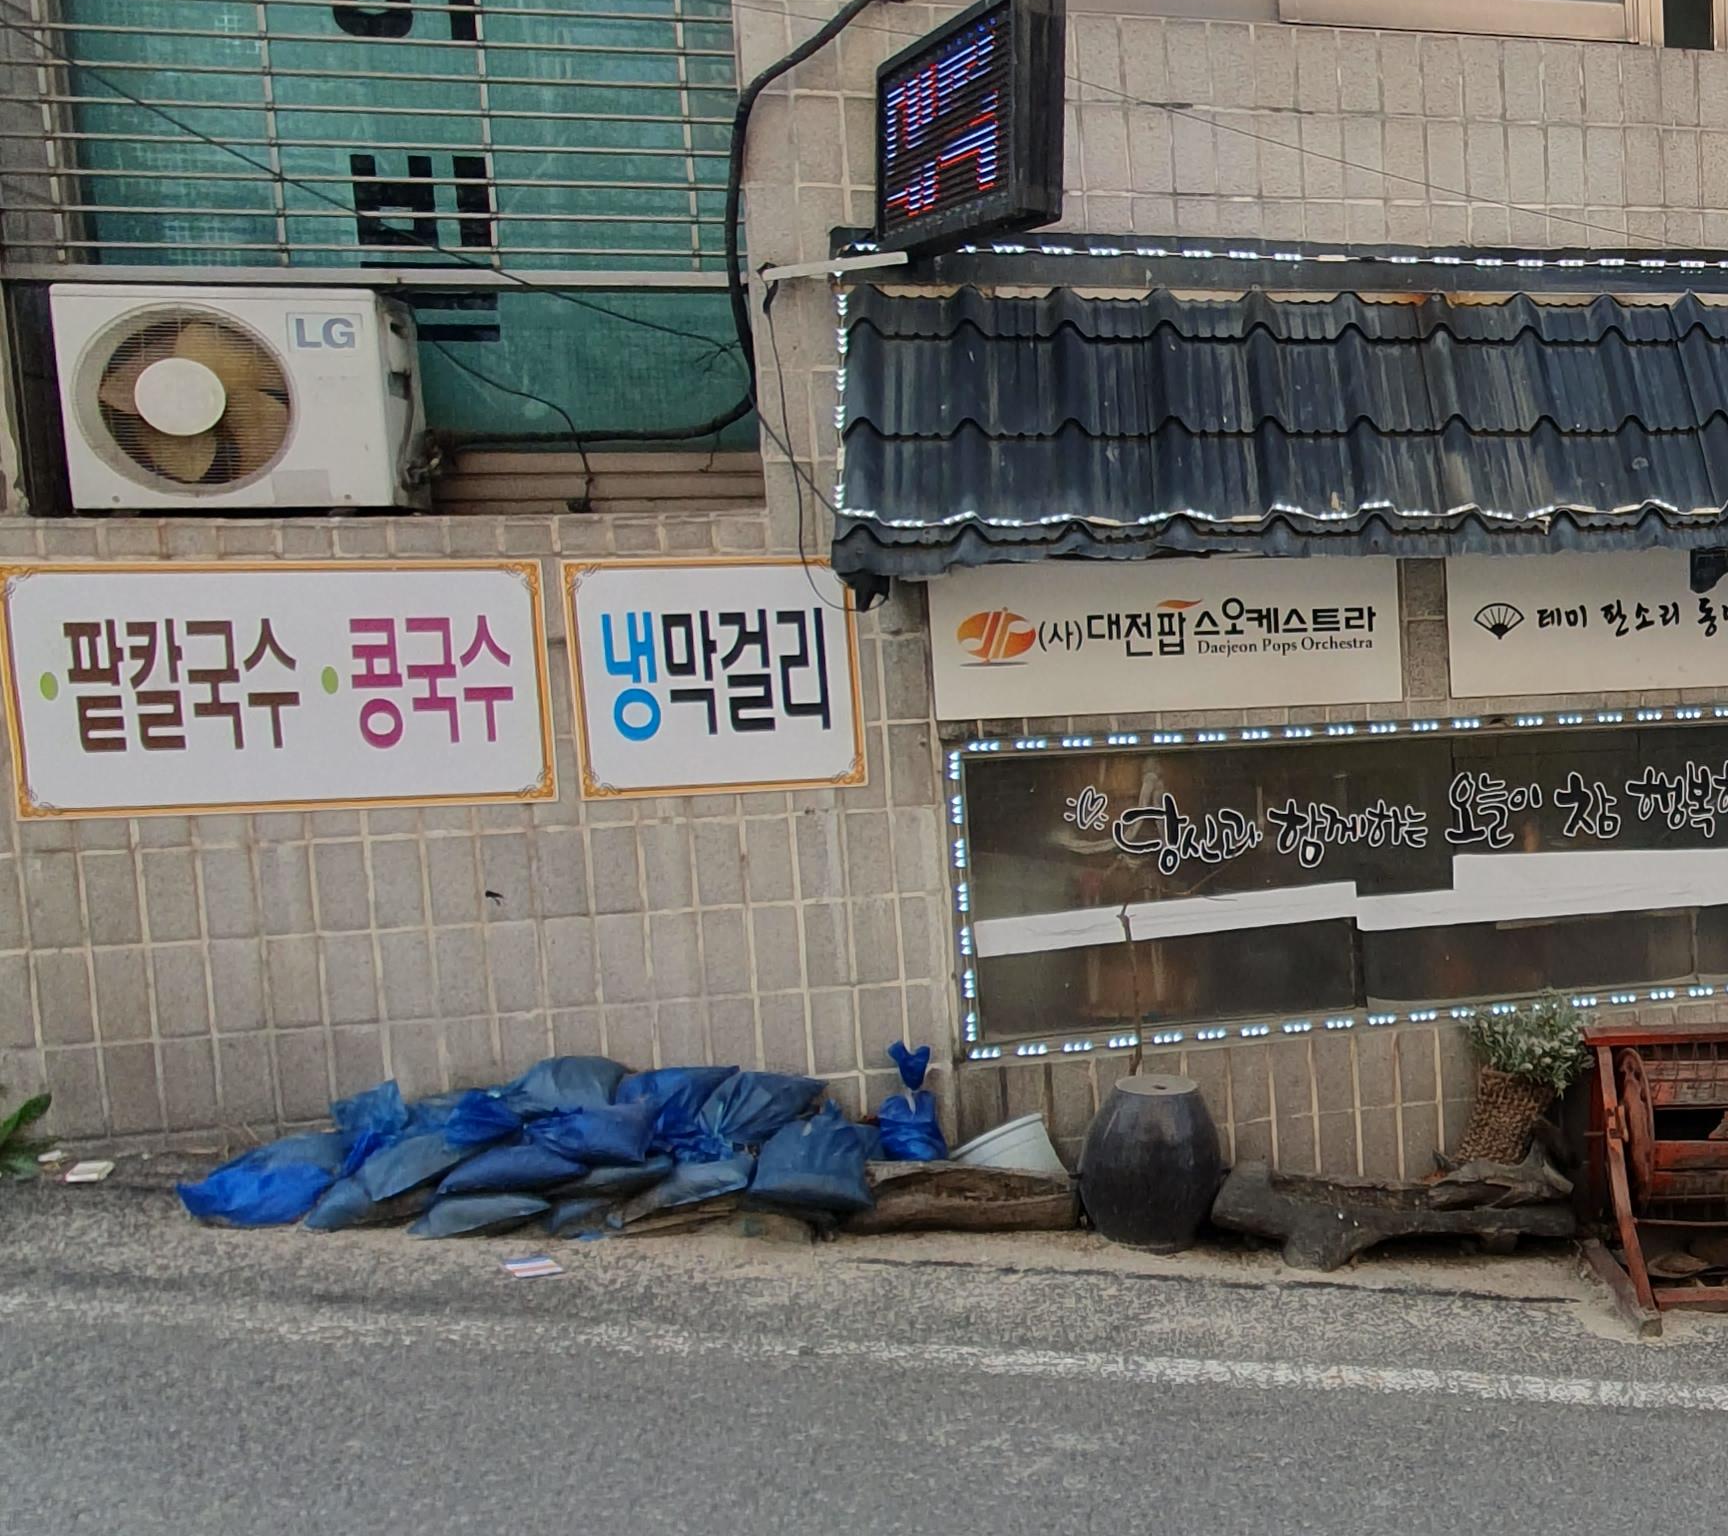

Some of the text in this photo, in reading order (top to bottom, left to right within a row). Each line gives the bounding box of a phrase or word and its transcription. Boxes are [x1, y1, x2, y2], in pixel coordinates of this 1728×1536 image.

[295, 317, 356, 349] LG
[1197, 635, 1374, 658] Daejeon Pops Orchestra
[1537, 604, 1589, 629] 테미
[1601, 598, 1682, 637] 판소리
[62, 614, 515, 755] 팥칼국수 콩국수
[601, 606, 832, 742] 냉막걸리
[1113, 792, 1264, 876] 당신과
[1445, 771, 1543, 849] 오늘이
[1554, 771, 1621, 839] 참
